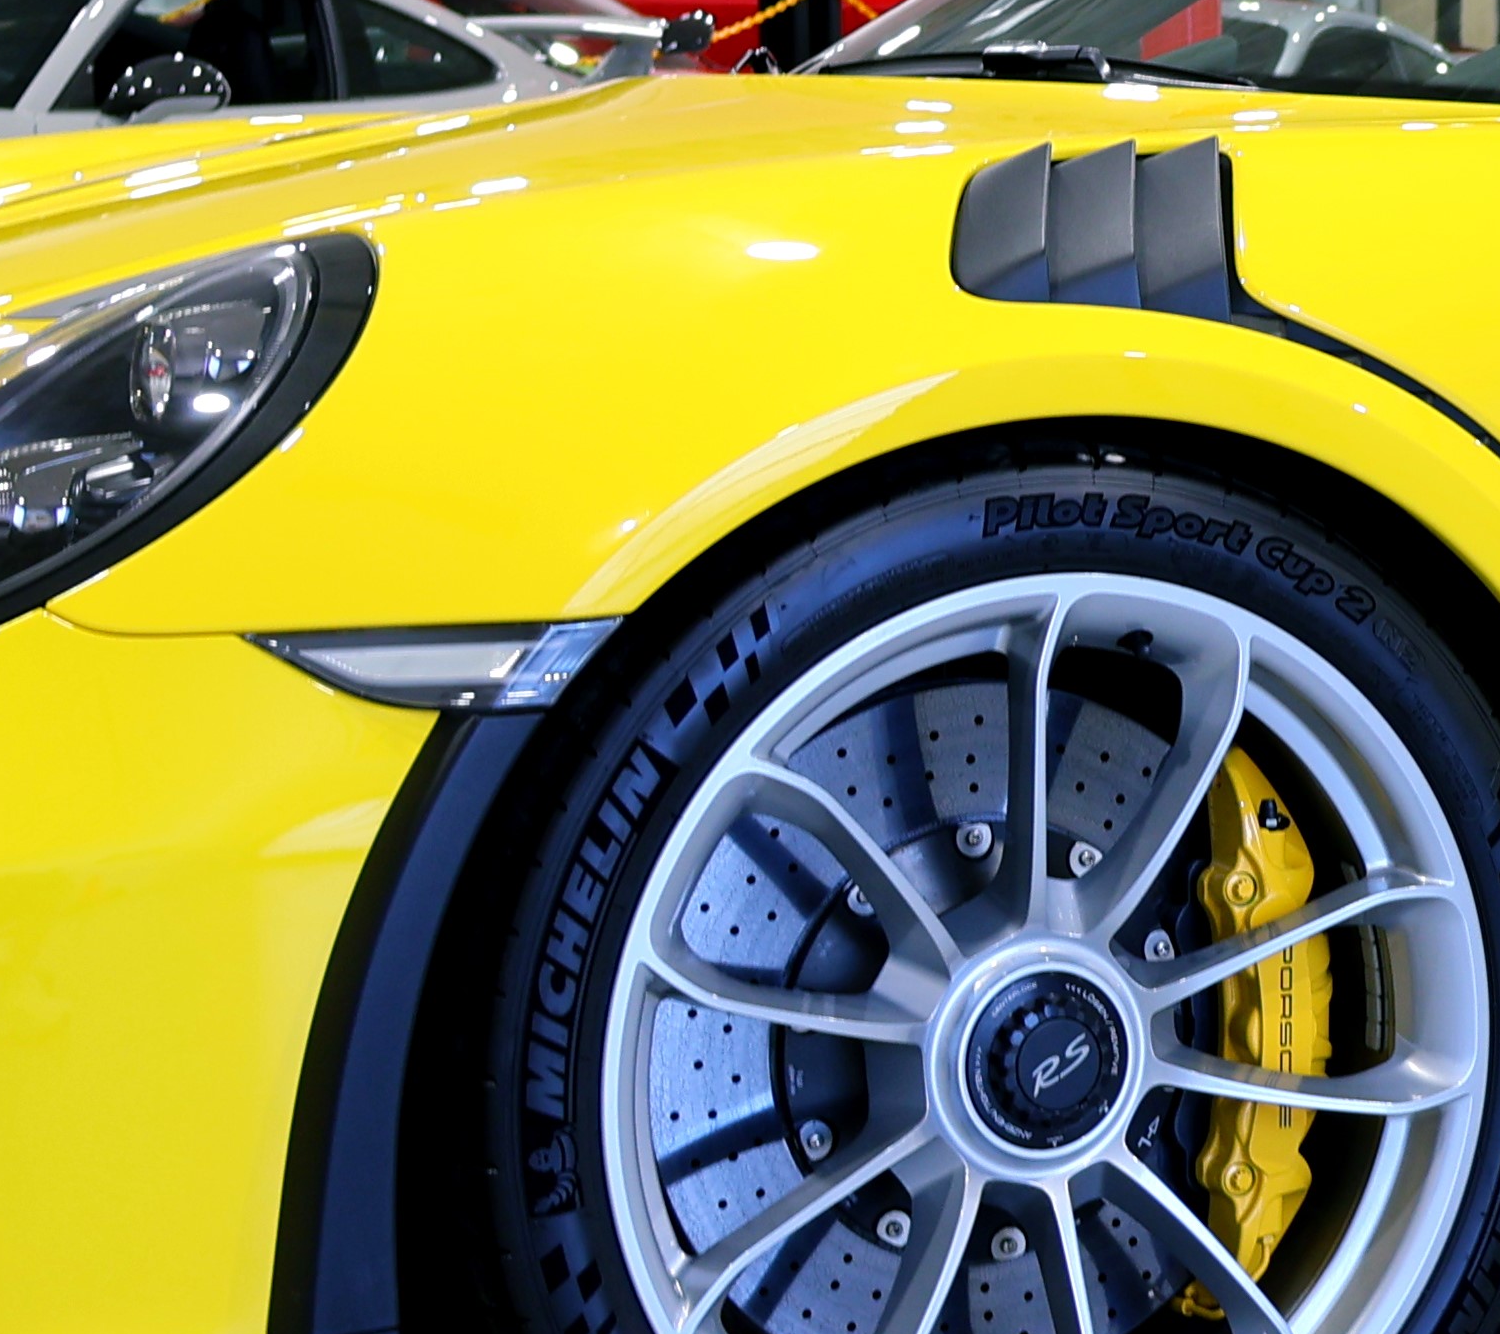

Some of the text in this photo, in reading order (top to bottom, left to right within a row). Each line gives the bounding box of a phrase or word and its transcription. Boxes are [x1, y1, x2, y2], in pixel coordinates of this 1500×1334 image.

[981, 492, 1108, 538] Pilot
[1110, 493, 1253, 555] Sport
[1254, 536, 1336, 597] Cup
[1335, 584, 1378, 625] 2
[525, 744, 662, 1121] MICHELIN
[1031, 1031, 1090, 1099] RS
[1278, 944, 1293, 1129] PORSCE
